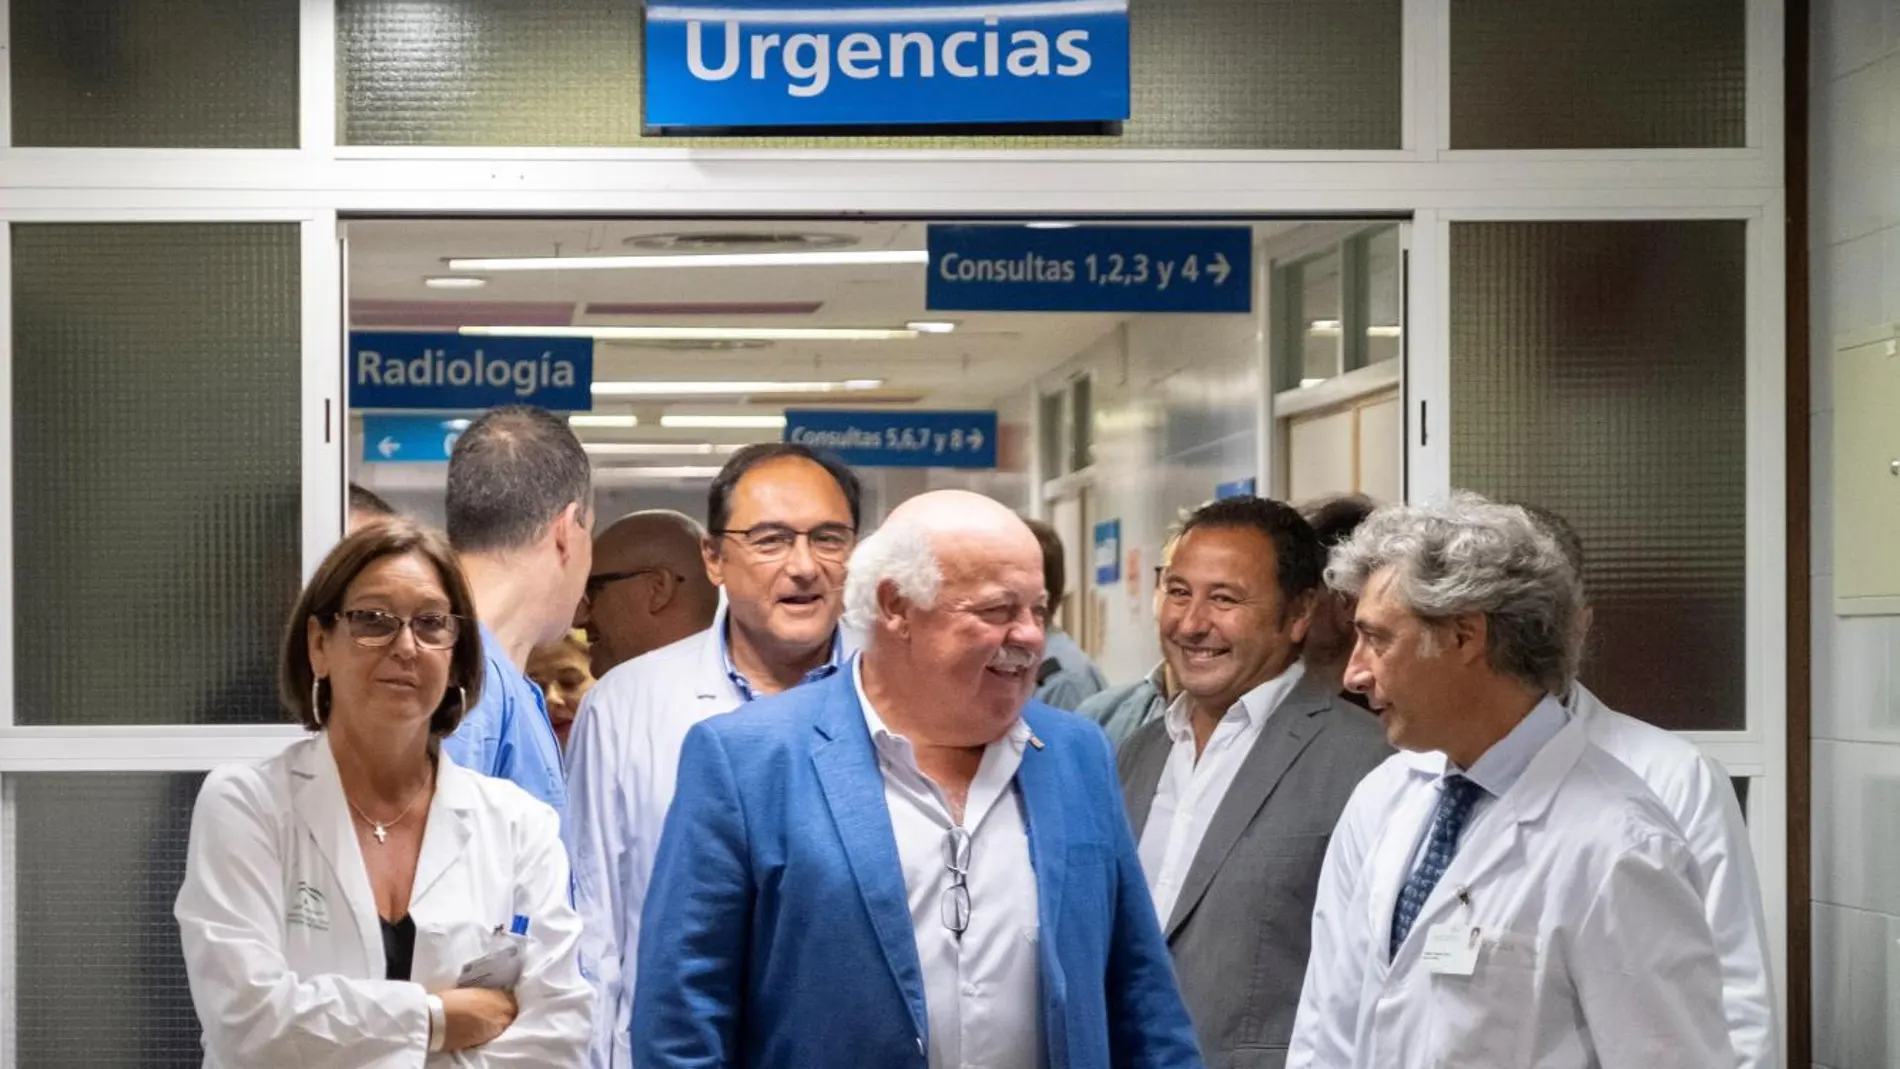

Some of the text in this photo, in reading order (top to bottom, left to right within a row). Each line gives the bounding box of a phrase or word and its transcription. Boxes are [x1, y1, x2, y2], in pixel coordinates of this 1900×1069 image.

[686, 15, 1092, 97] Urgencias
[940, 252, 1199, 290] Consultas 1,2,3 y 4
[357, 349, 575, 395] Radiología
[791, 426, 882, 448] Consultas
[934, 433, 945, 455] y
[950, 428, 964, 449] 8
